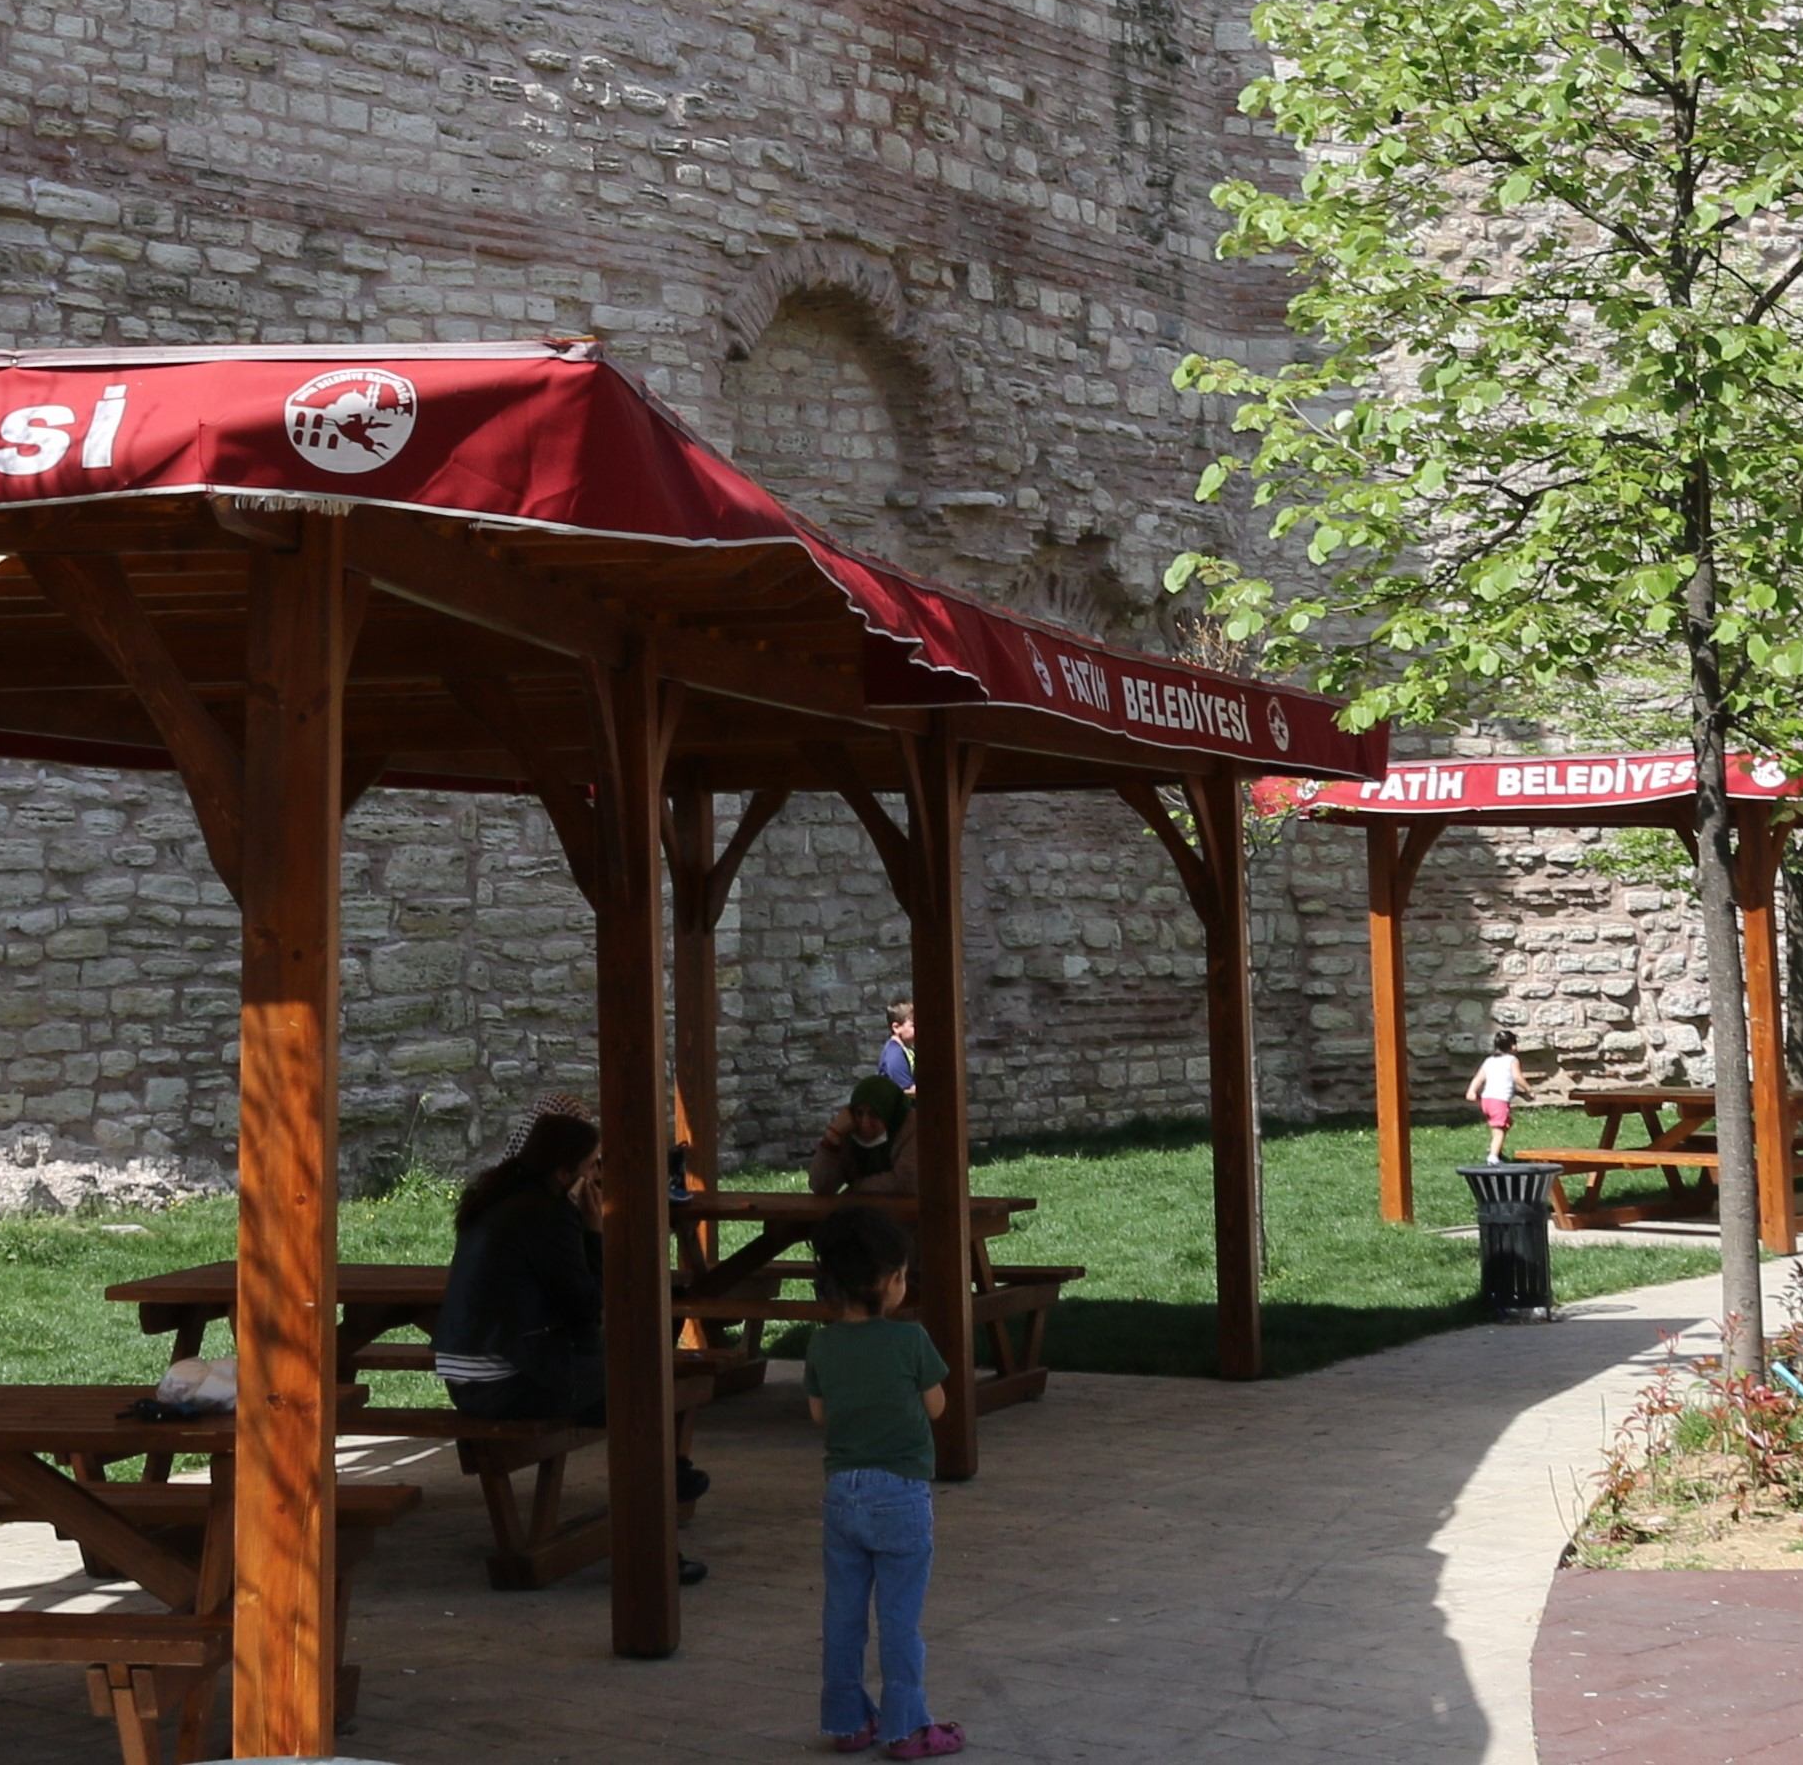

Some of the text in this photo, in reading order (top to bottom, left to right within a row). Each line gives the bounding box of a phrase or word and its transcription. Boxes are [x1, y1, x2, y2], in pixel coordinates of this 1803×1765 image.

[1058, 654, 1252, 744] FATİH BELEDİYESİ
[1497, 758, 1697, 795] BELEDİYES
